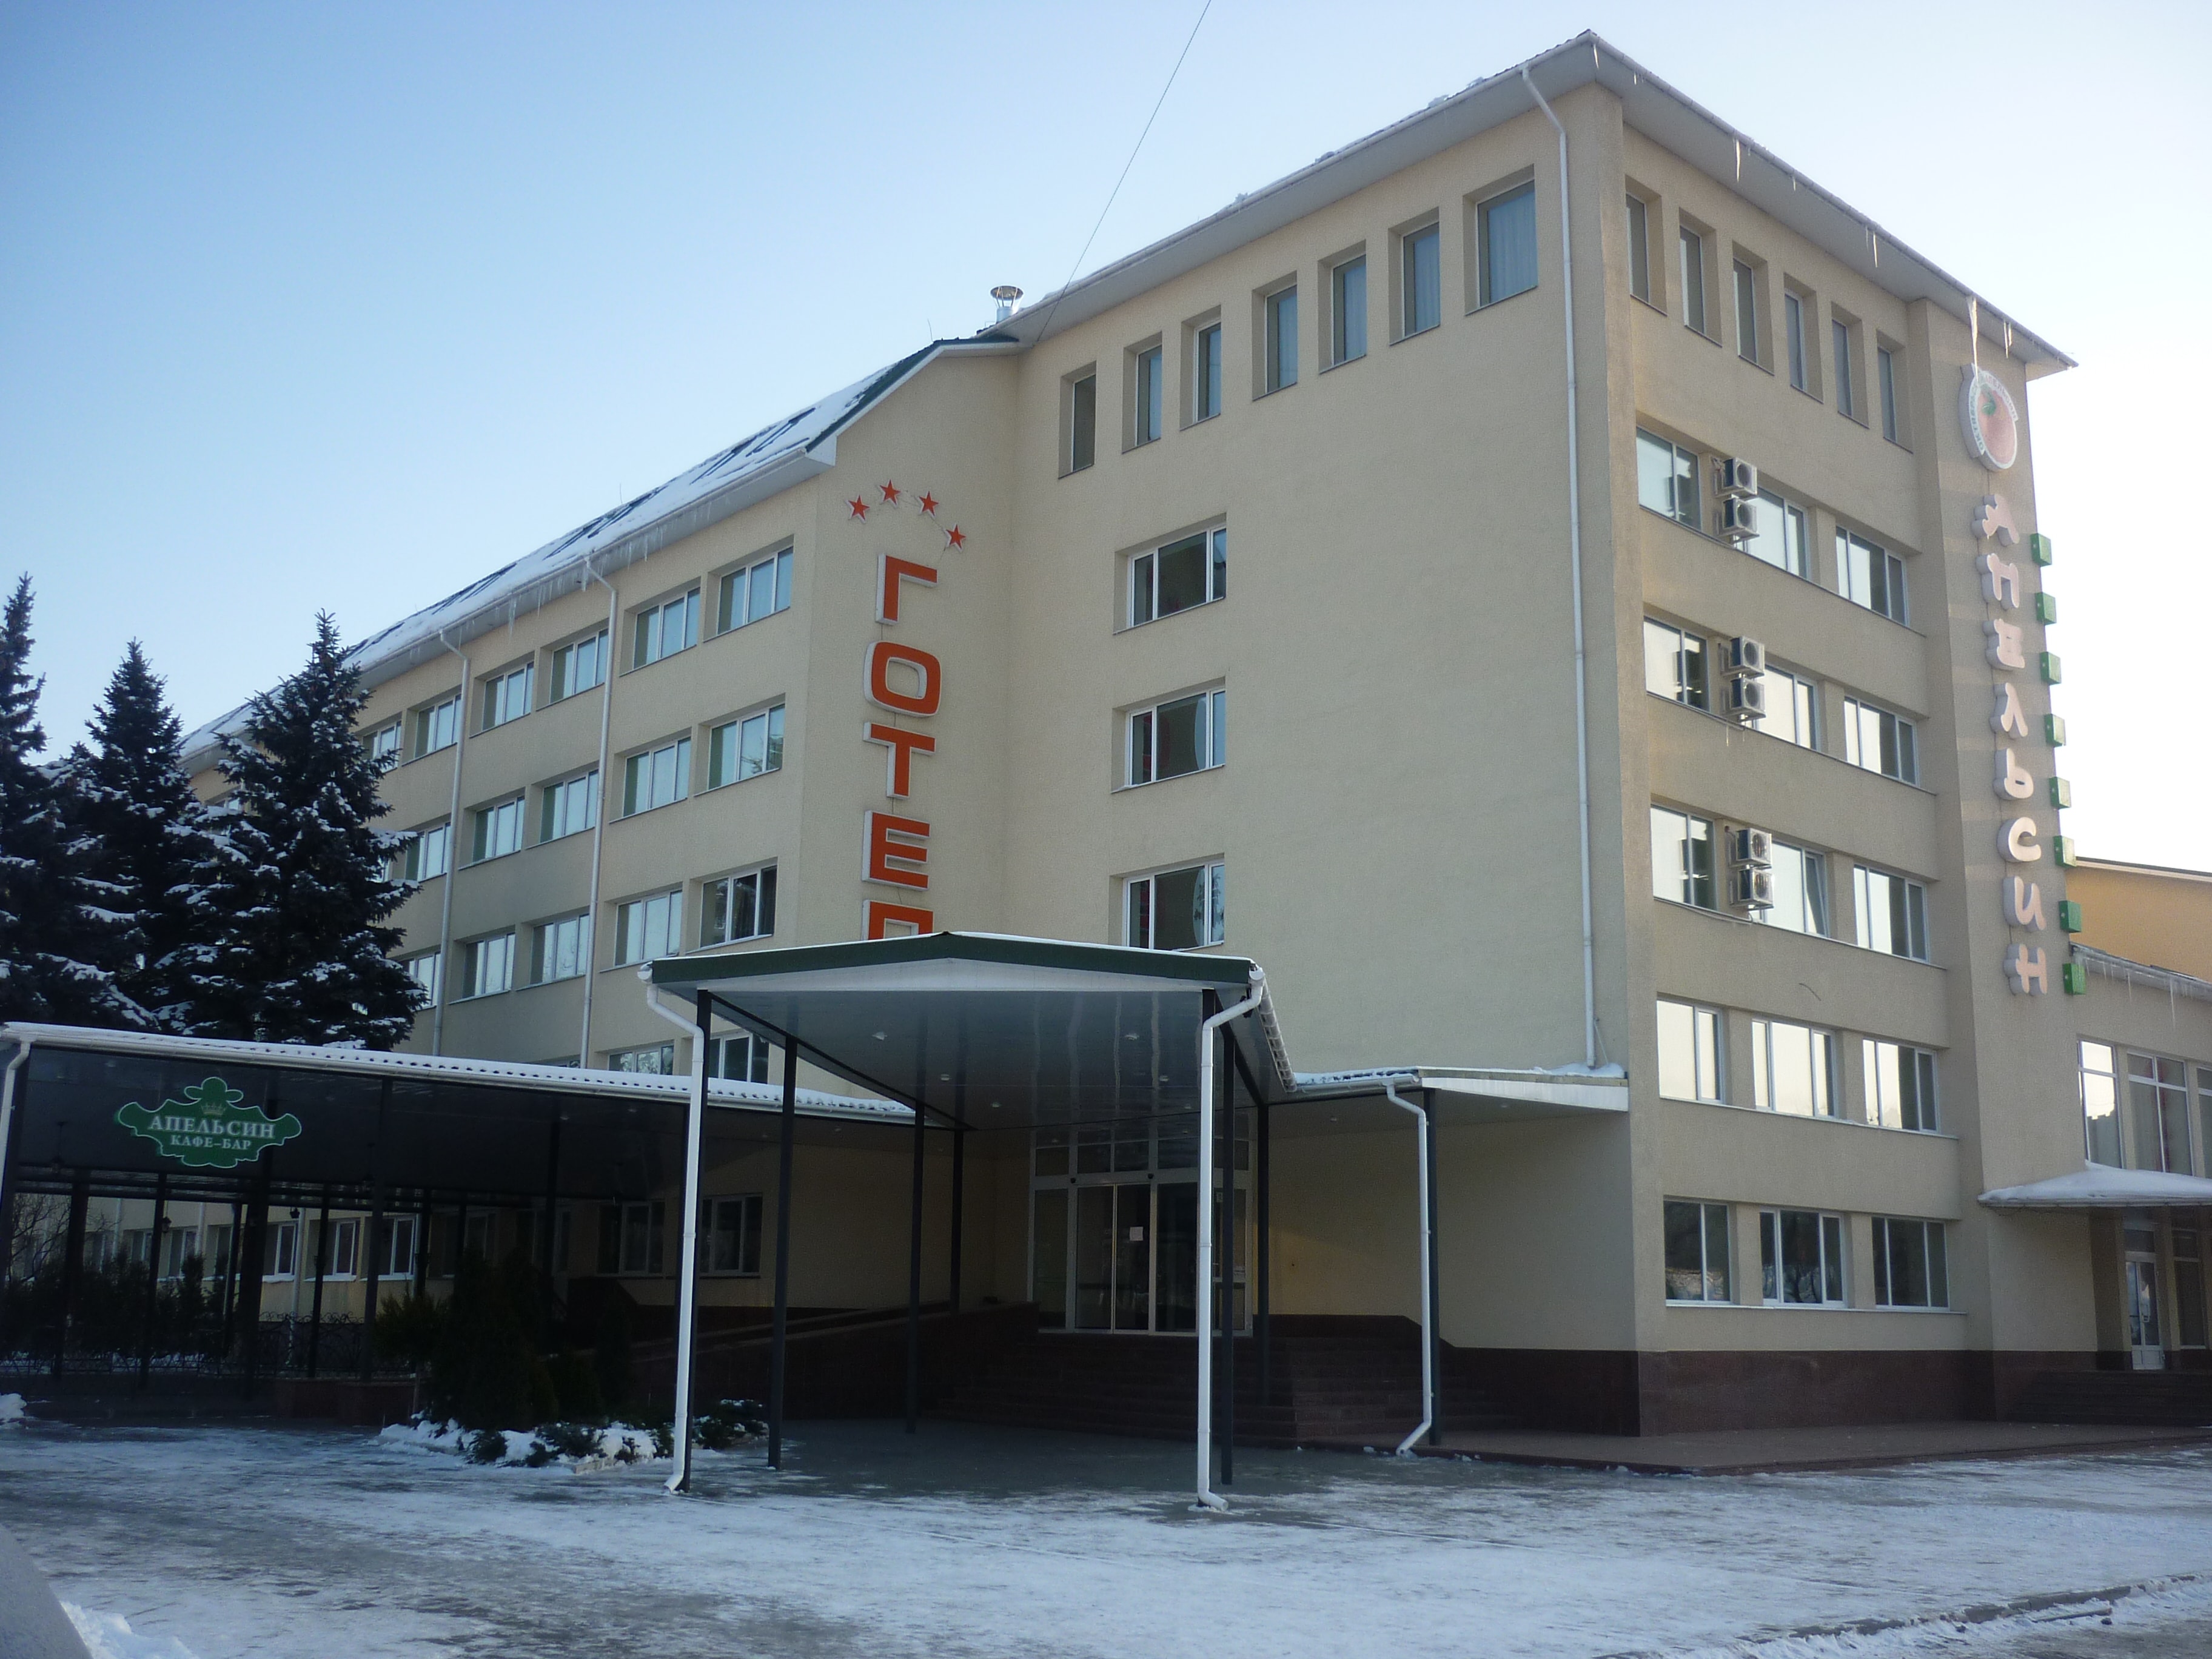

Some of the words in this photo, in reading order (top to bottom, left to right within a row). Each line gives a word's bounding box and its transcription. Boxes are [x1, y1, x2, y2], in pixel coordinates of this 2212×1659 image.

[1972, 494, 2048, 995] АПЕЛЬСИН
[149, 1116, 275, 1138] АПЕЛЬСИН
[172, 1134, 251, 1150] КАФЕ-БАР
